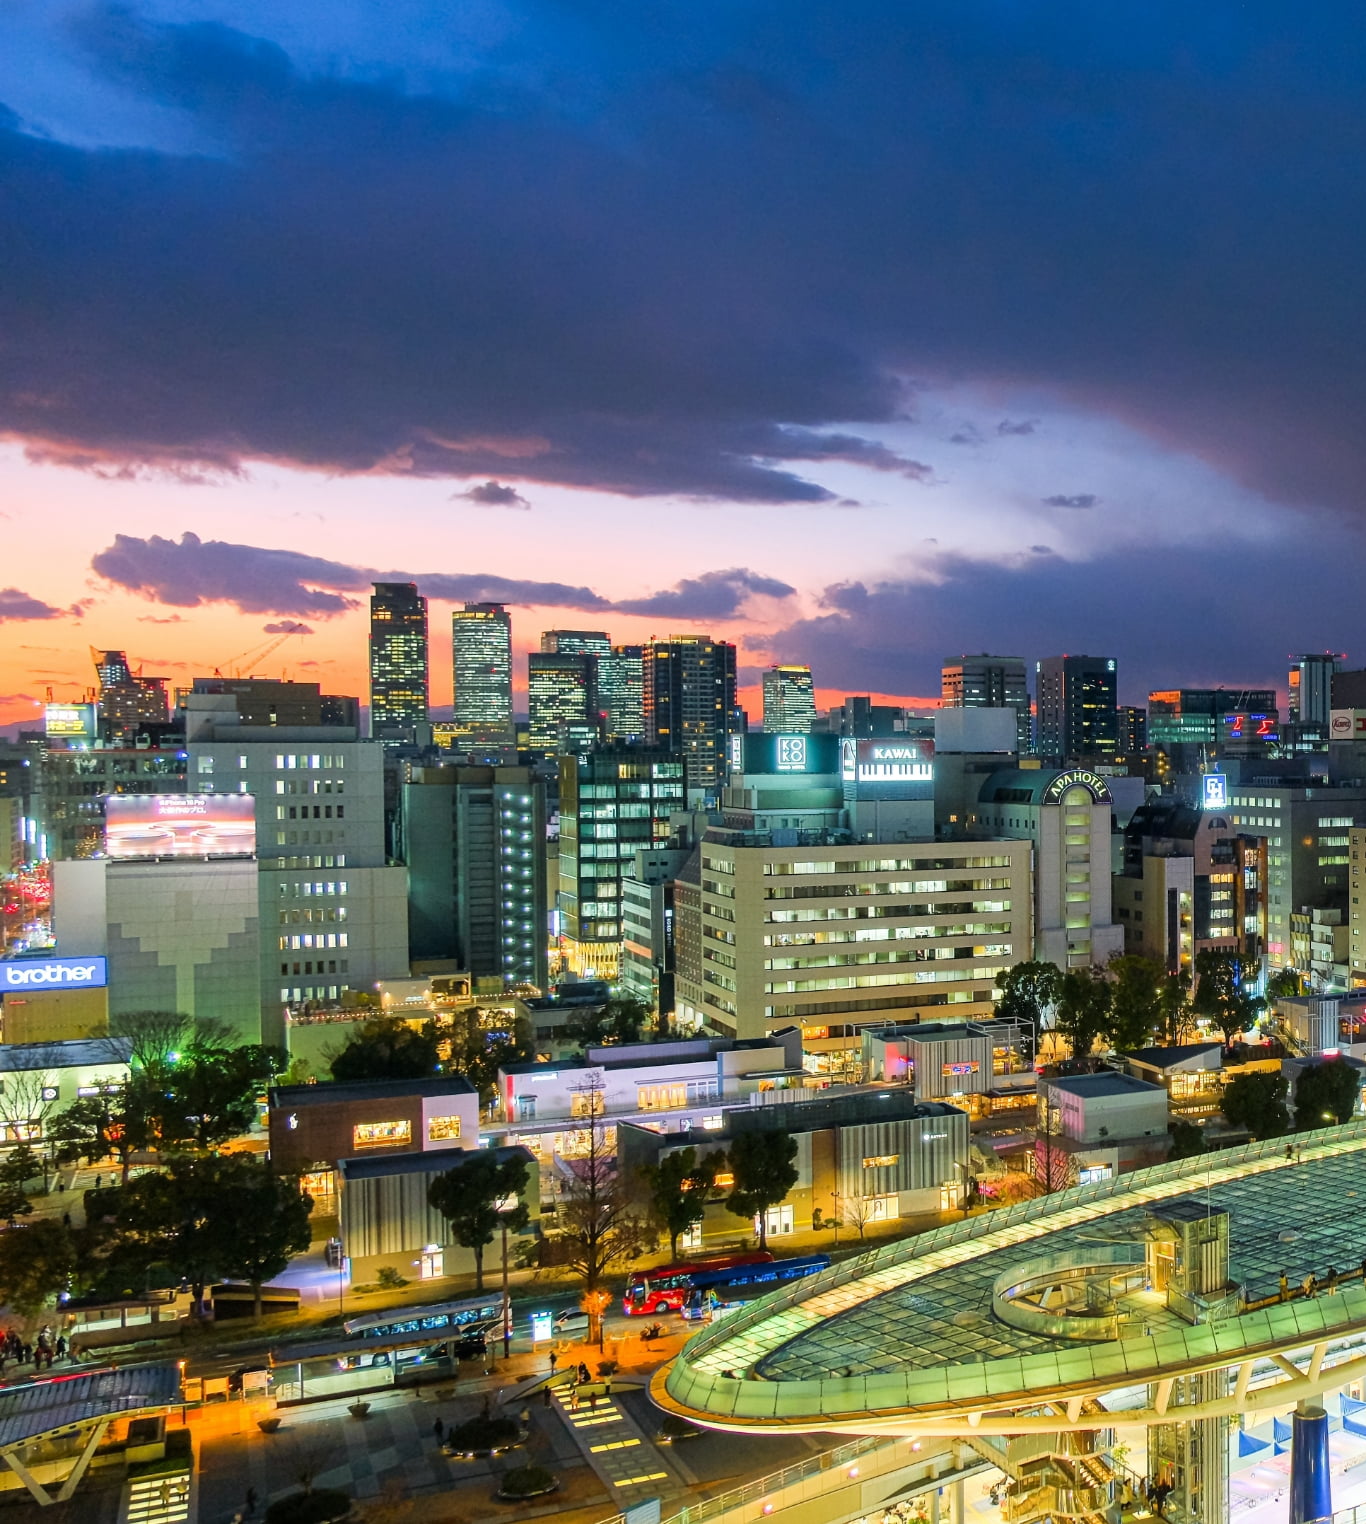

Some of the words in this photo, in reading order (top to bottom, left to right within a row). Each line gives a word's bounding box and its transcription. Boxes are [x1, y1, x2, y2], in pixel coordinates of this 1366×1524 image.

[874, 748, 917, 759] KAWAI
[1051, 775, 1073, 797] APA
[1073, 772, 1107, 798] HOTEL
[6, 964, 96, 985] brother
